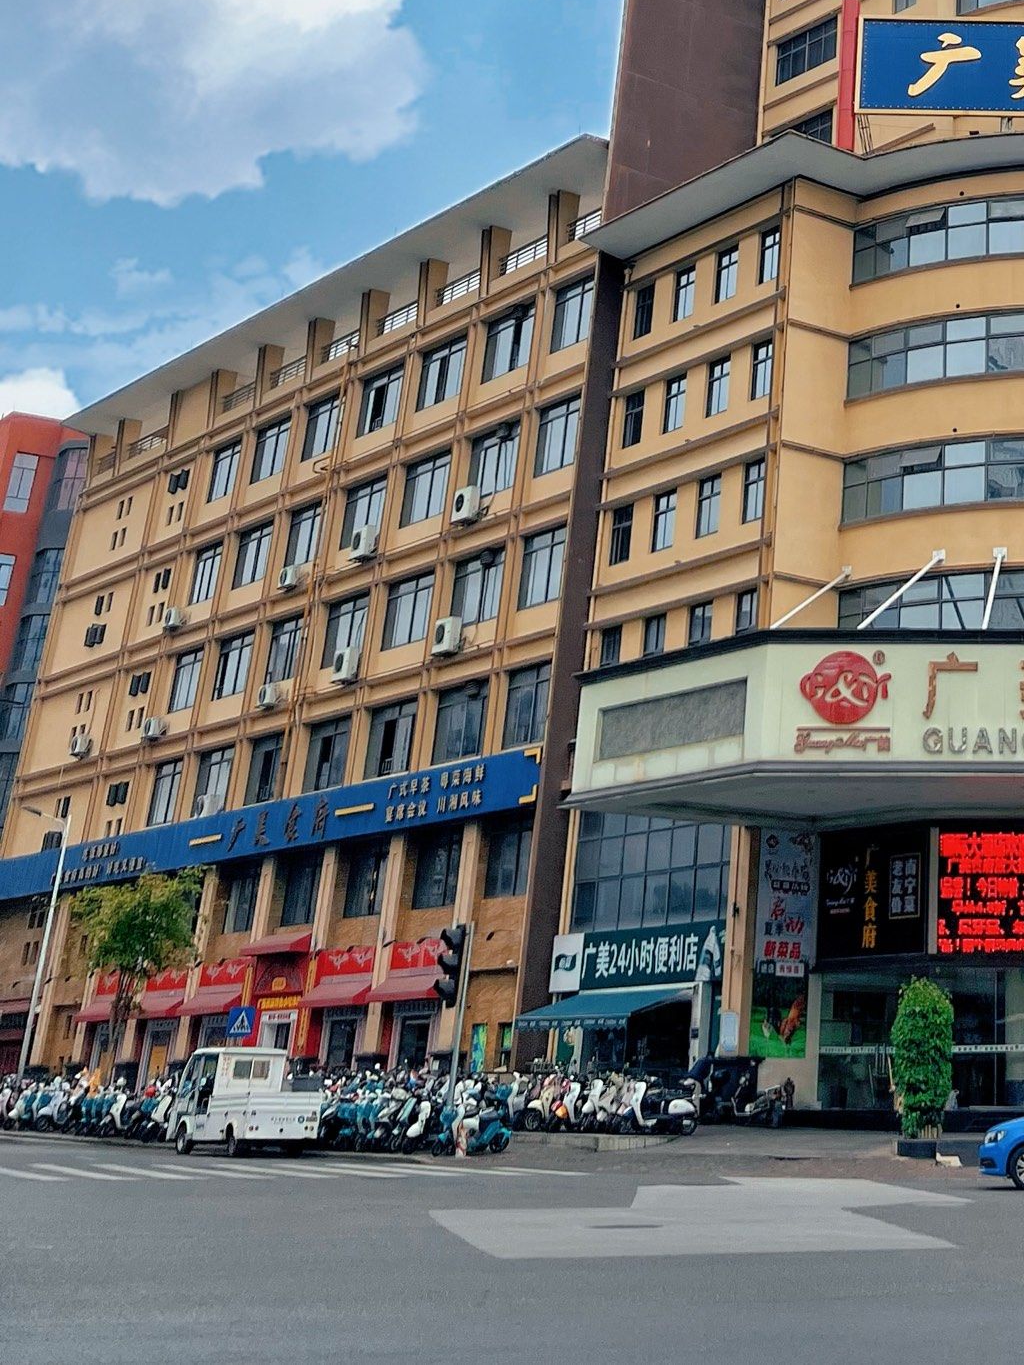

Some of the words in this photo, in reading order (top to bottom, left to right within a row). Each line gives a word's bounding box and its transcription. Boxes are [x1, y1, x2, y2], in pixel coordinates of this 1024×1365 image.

[581, 933, 700, 980] 广美24小时便利店
